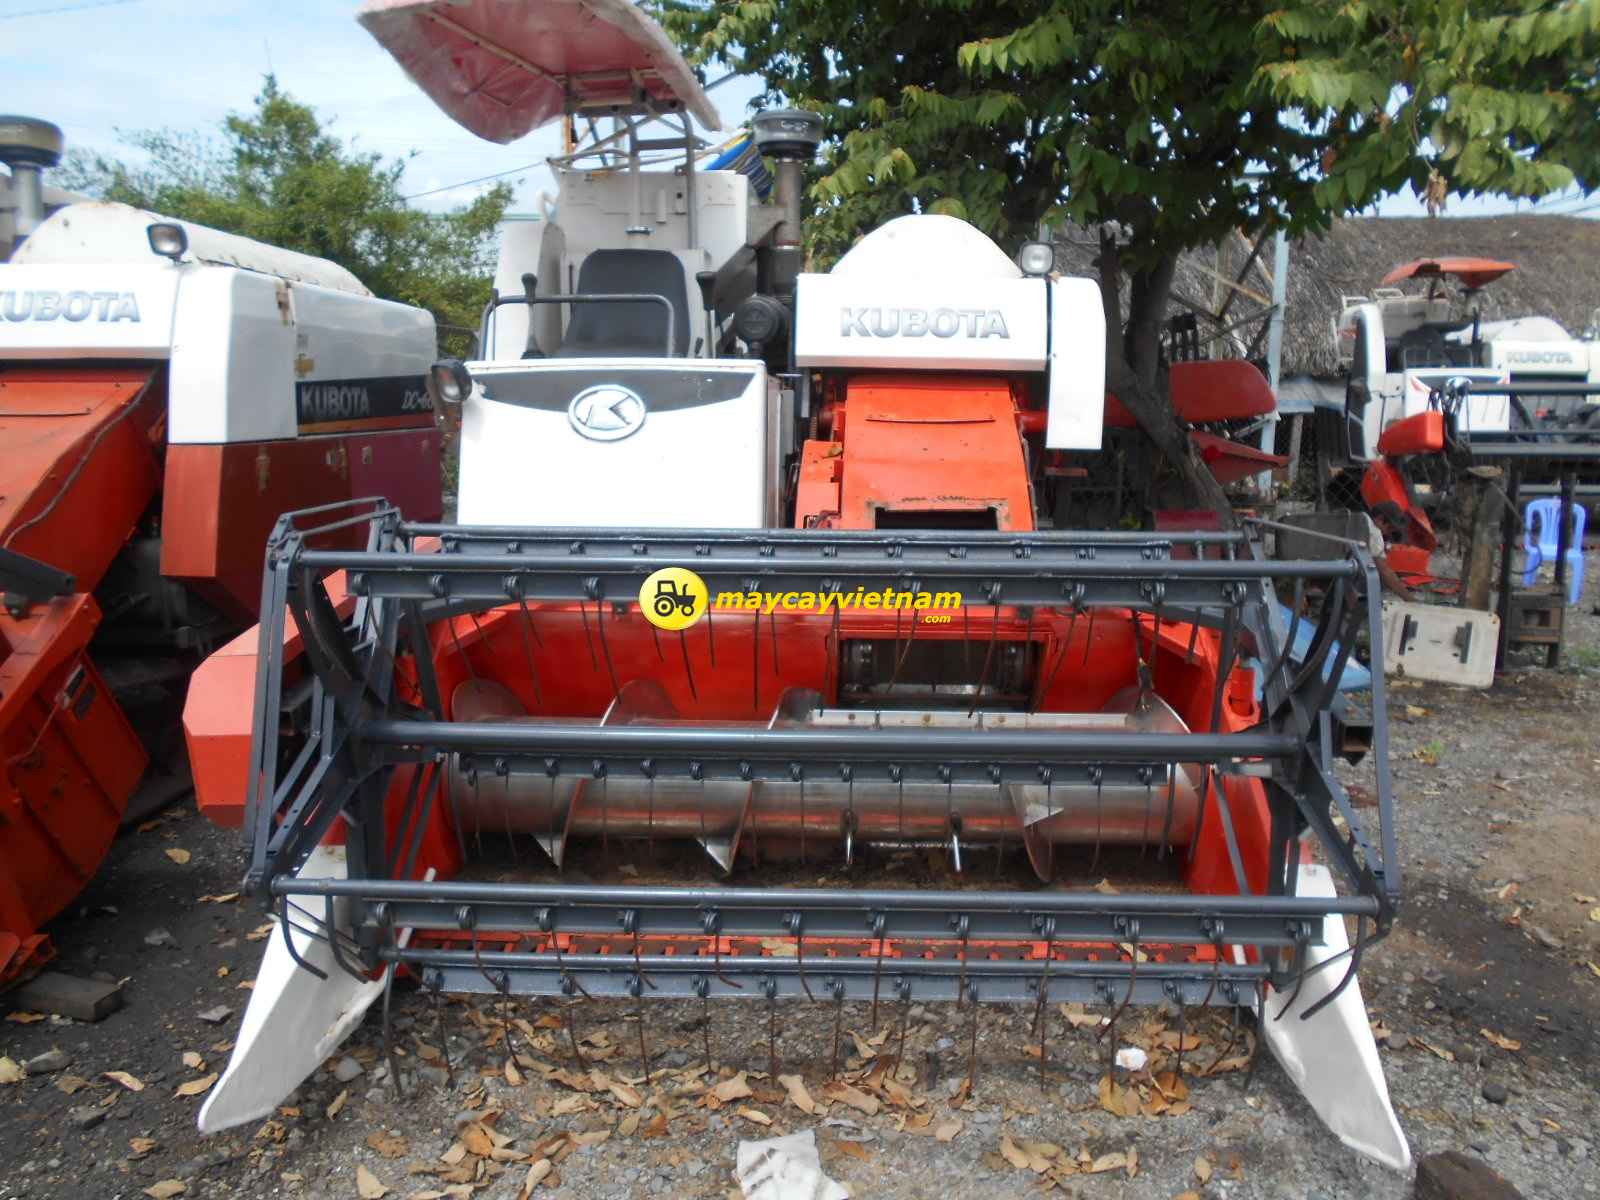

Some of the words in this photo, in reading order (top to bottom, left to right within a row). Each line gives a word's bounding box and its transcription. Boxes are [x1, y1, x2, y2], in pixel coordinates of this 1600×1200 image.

[0, 290, 141, 323] UBOTA
[840, 307, 1010, 339] KUBOTA
[1506, 351, 1574, 364] KUBOTA
[301, 385, 371, 418] KUBOTA
